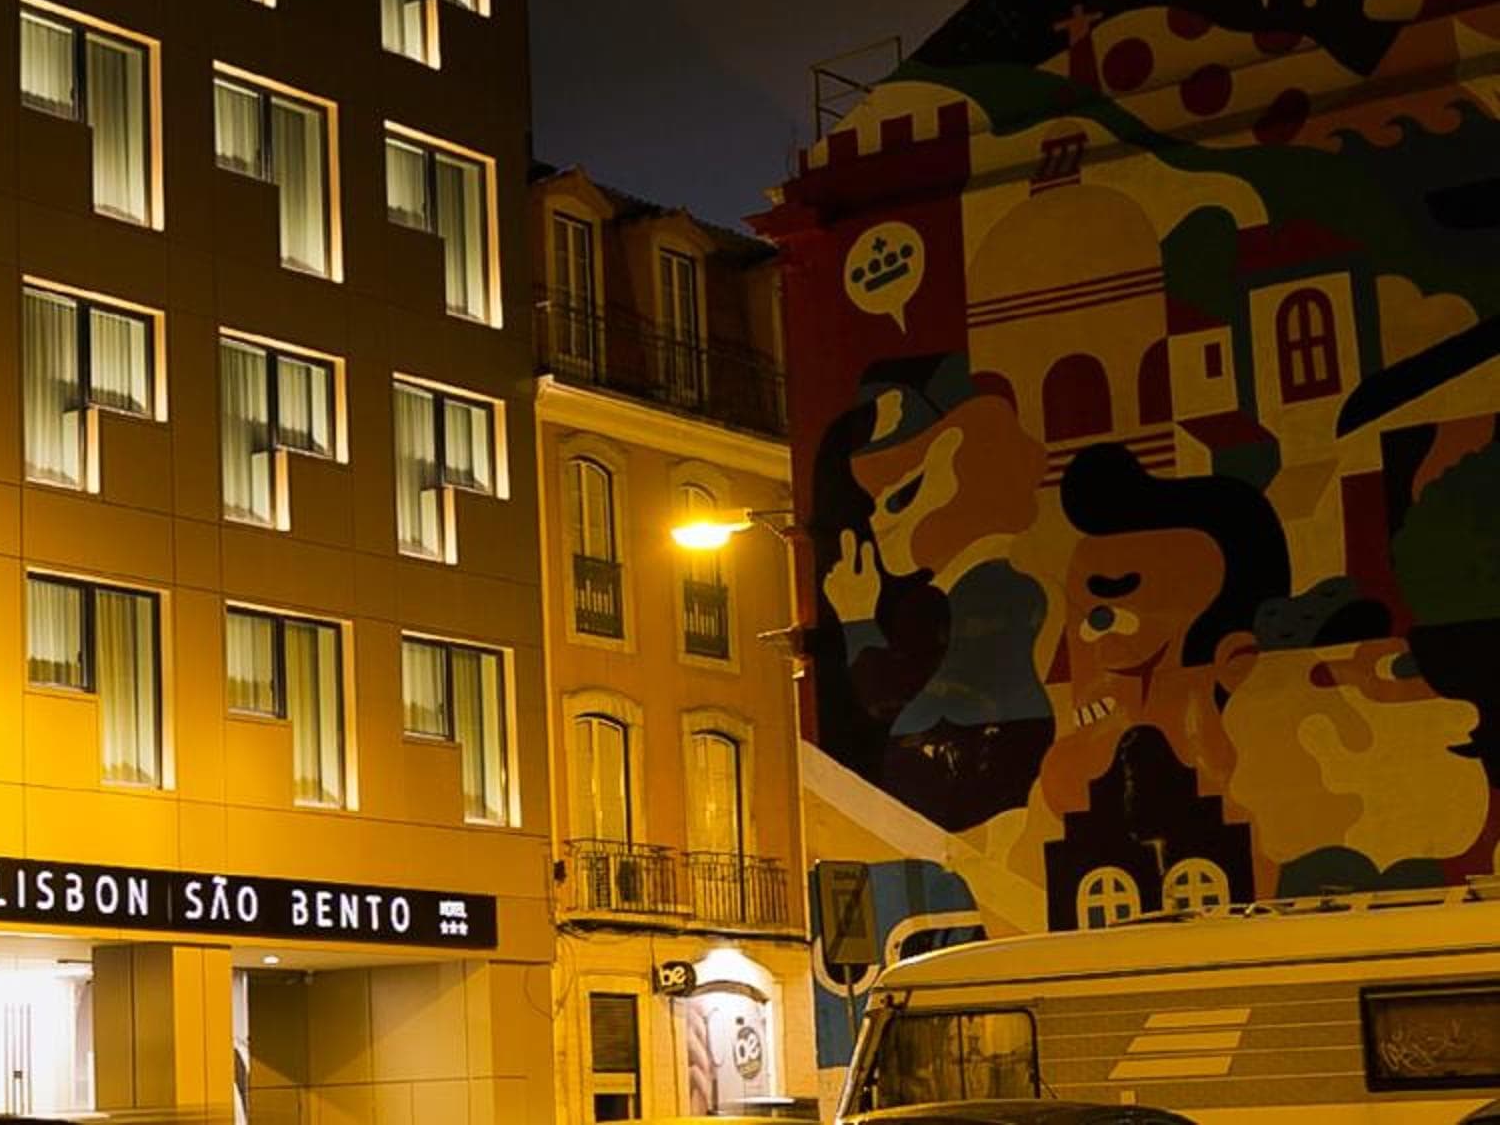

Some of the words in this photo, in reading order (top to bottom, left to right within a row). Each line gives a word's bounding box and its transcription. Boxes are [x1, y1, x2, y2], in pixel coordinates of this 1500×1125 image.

[185, 874, 258, 922] SÃO
[291, 889, 411, 933] BENTO
[659, 965, 686, 986] be
